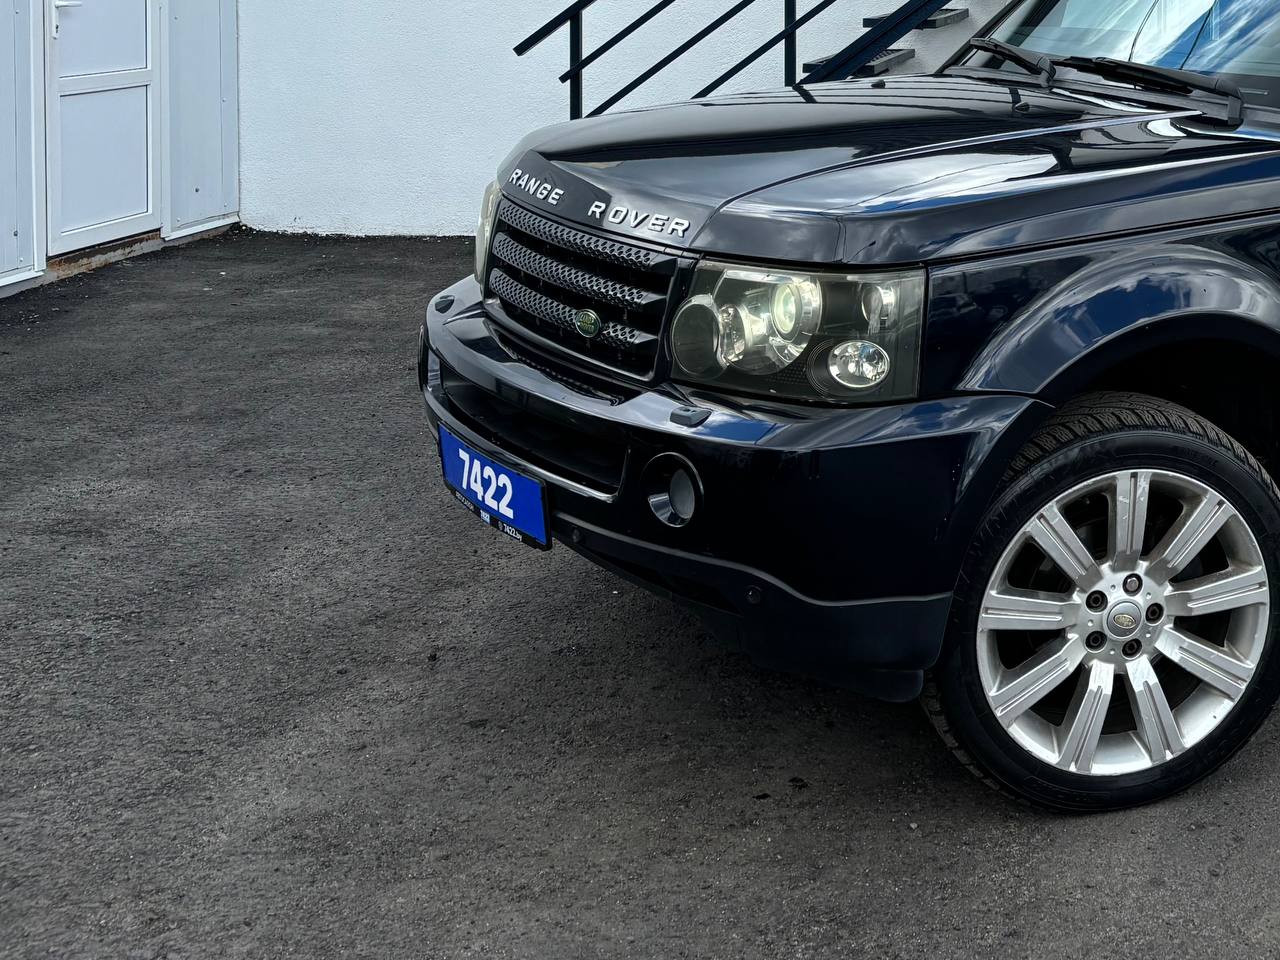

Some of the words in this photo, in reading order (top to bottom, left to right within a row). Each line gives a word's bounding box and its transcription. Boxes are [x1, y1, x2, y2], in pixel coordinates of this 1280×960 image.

[508, 168, 565, 206] RANGE
[587, 200, 691, 238] ROVER
[458, 447, 514, 520] 7422
